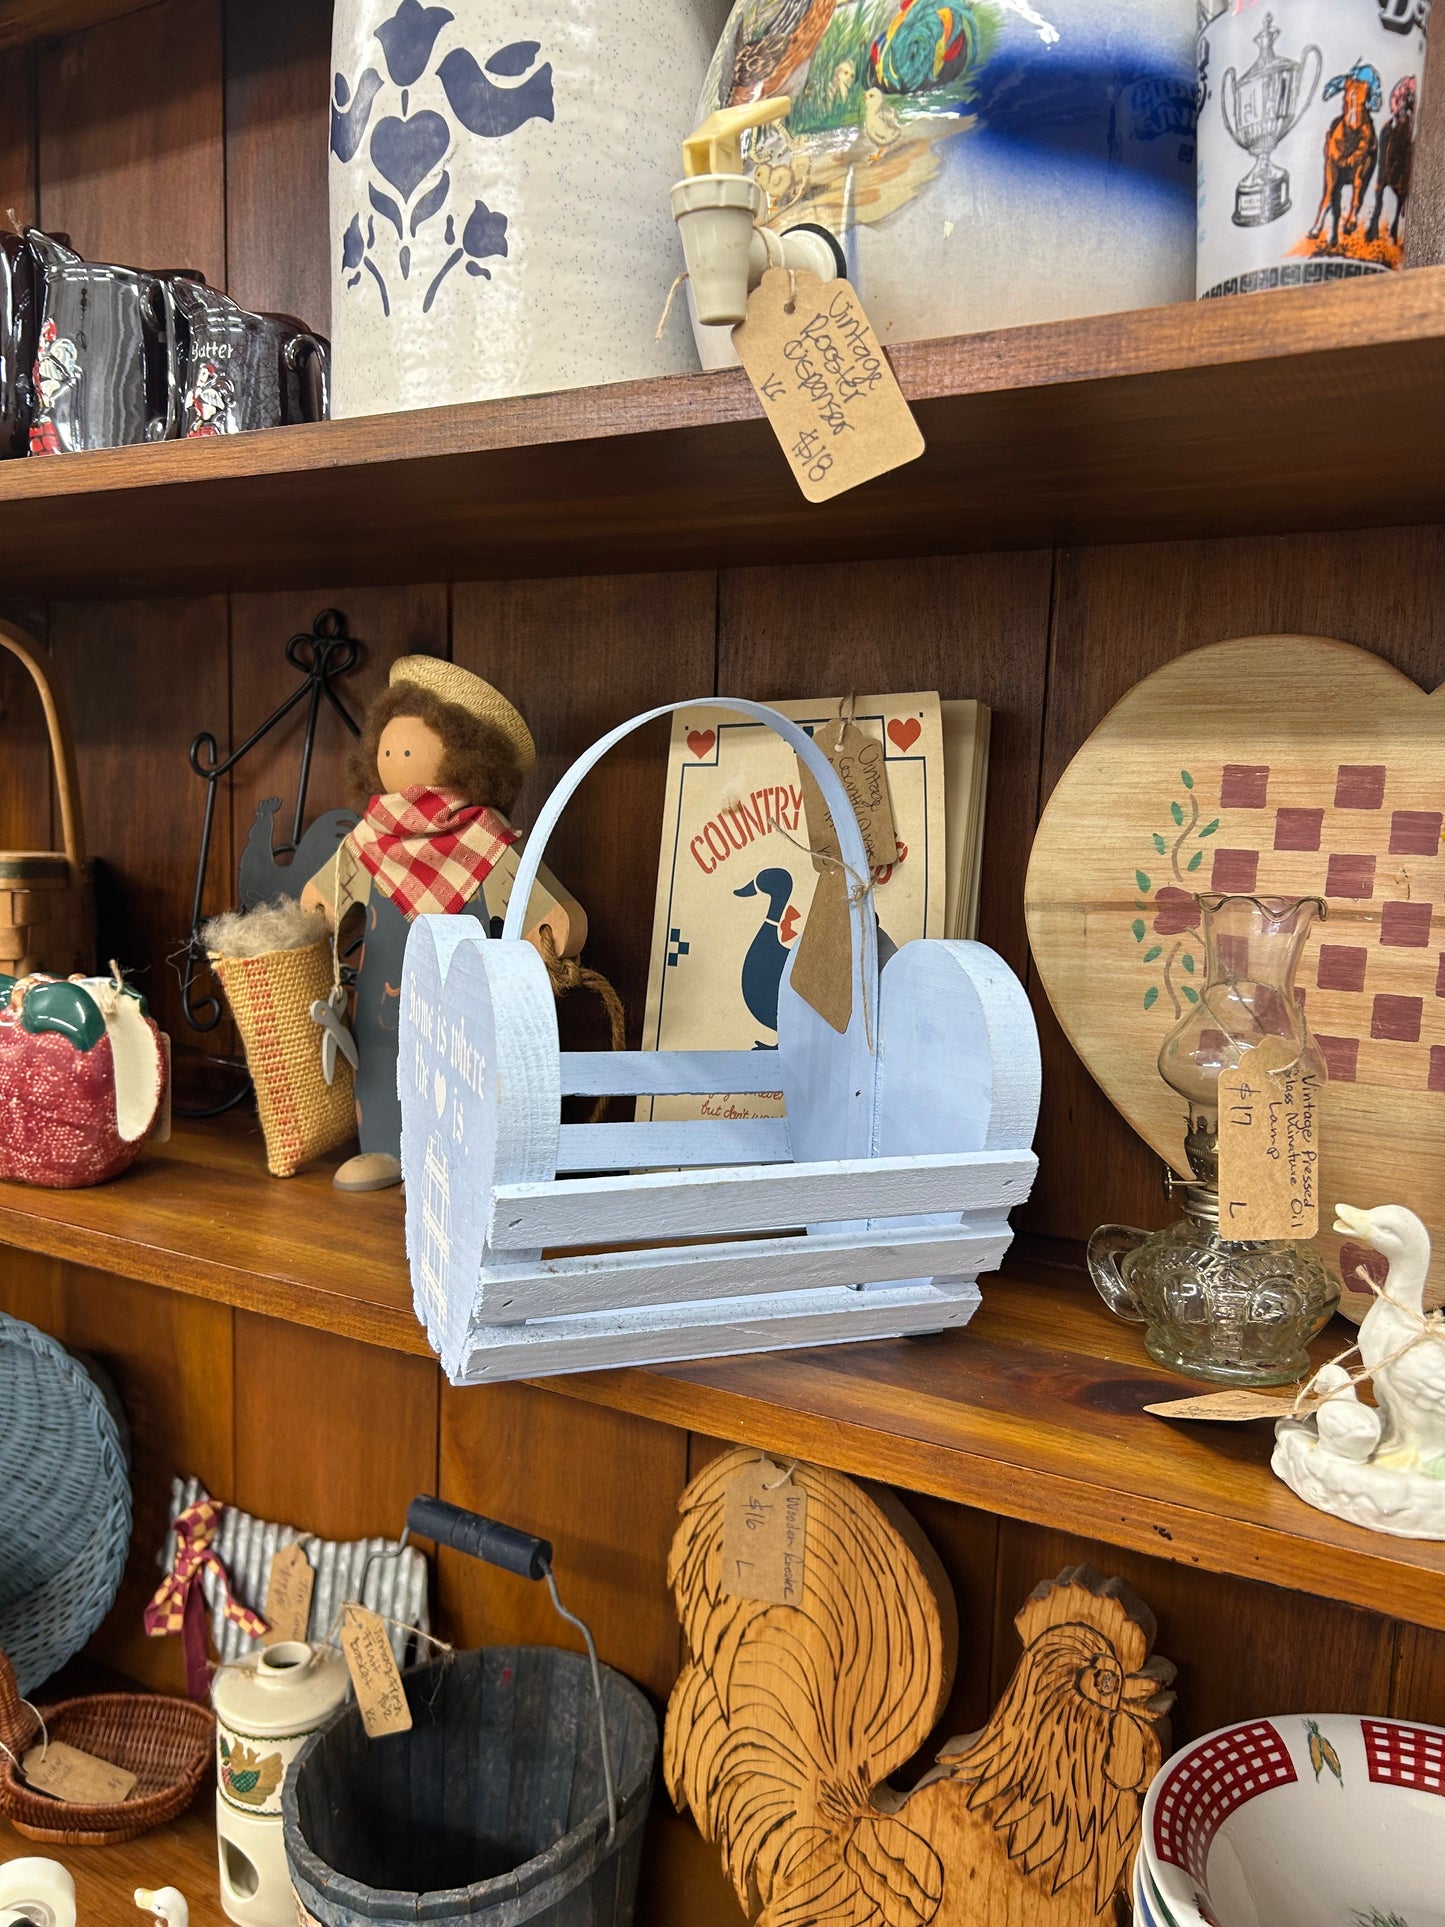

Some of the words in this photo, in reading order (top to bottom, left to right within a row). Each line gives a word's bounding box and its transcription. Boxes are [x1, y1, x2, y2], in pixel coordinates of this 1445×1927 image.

[191, 340, 234, 362] Butter
[800, 312, 867, 404] Rooster
[829, 290, 882, 391] Vintage
[791, 429, 834, 482] $18
[690, 784, 804, 875] COUNTRY
[436, 1004, 447, 1058] is
[700, 1099, 722, 1117] but
[1225, 1083, 1262, 1126] $17
[1266, 1101, 1283, 1160] Lamp
[1295, 1073, 1320, 1143] Vintage
[1301, 1149, 1318, 1208] Pressed
[1228, 1201, 1248, 1219] L
[1290, 1198, 1304, 1228] Oil
[739, 1496, 774, 1531] $16
